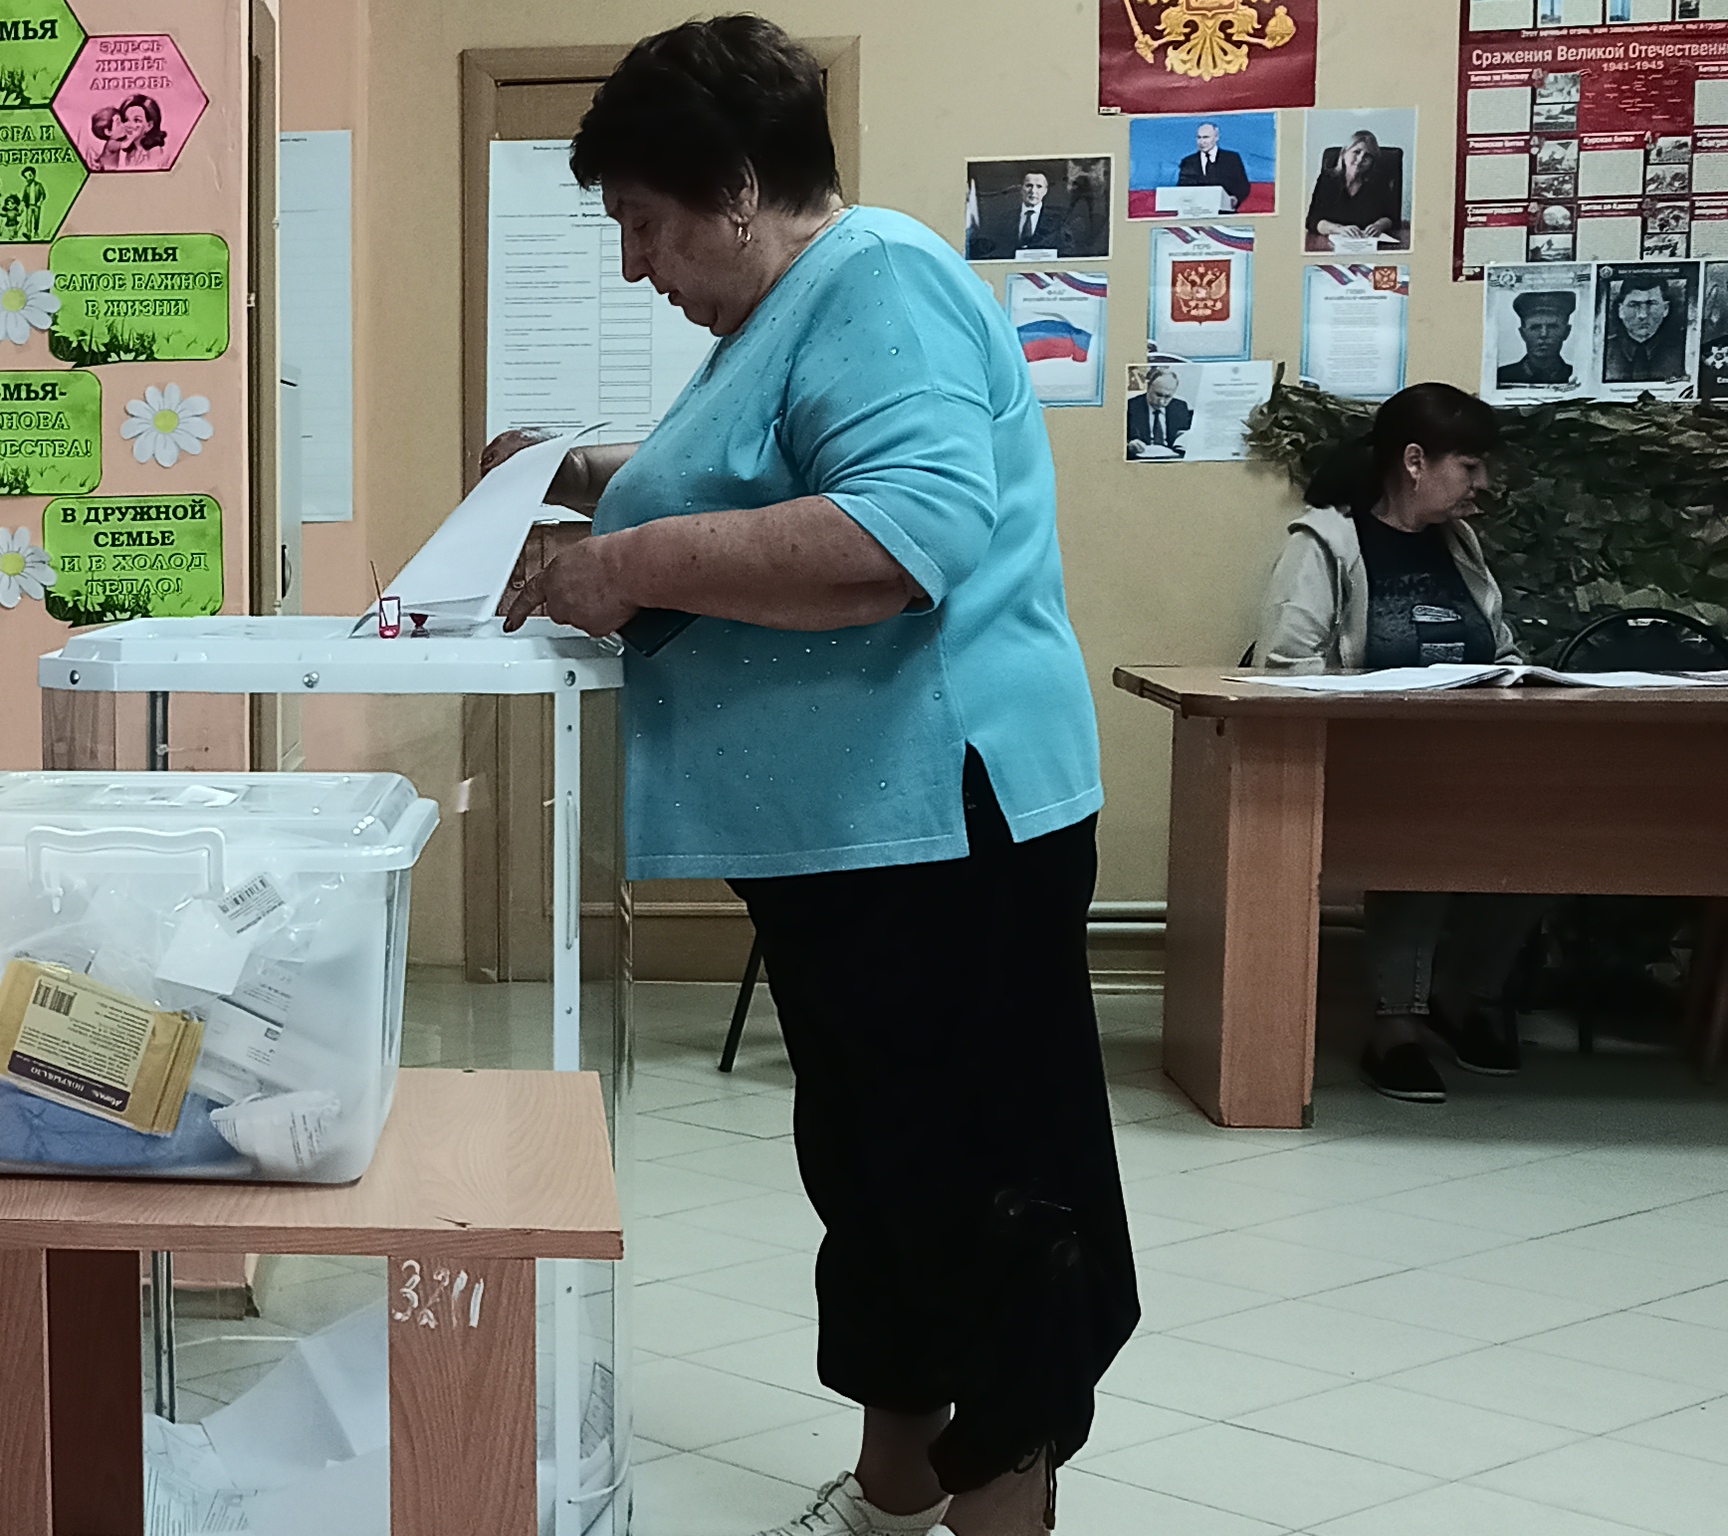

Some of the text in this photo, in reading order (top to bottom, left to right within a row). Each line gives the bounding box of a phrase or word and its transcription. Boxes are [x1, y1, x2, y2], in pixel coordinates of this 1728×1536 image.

[99, 40, 164, 54] ЗДЕСЬ
[1472, 41, 1728, 69] Сражения Великой Отечественн
[95, 57, 166, 72] ЖИВЁТ
[89, 75, 173, 91] ЛЮБОВЬ
[40, 125, 56, 141] И
[103, 246, 178, 264] СЕМЬЯ
[53, 271, 224, 292] САМОЕ ВАЖНОЕ
[85, 298, 191, 317] В ЖИЗНИ!
[61, 498, 207, 525] В ДРУЖНОЙ
[93, 530, 175, 548] СЕМЬЕ
[61, 553, 209, 573] И В ХОЛОД
[85, 577, 183, 598] ТЕПЛО!
